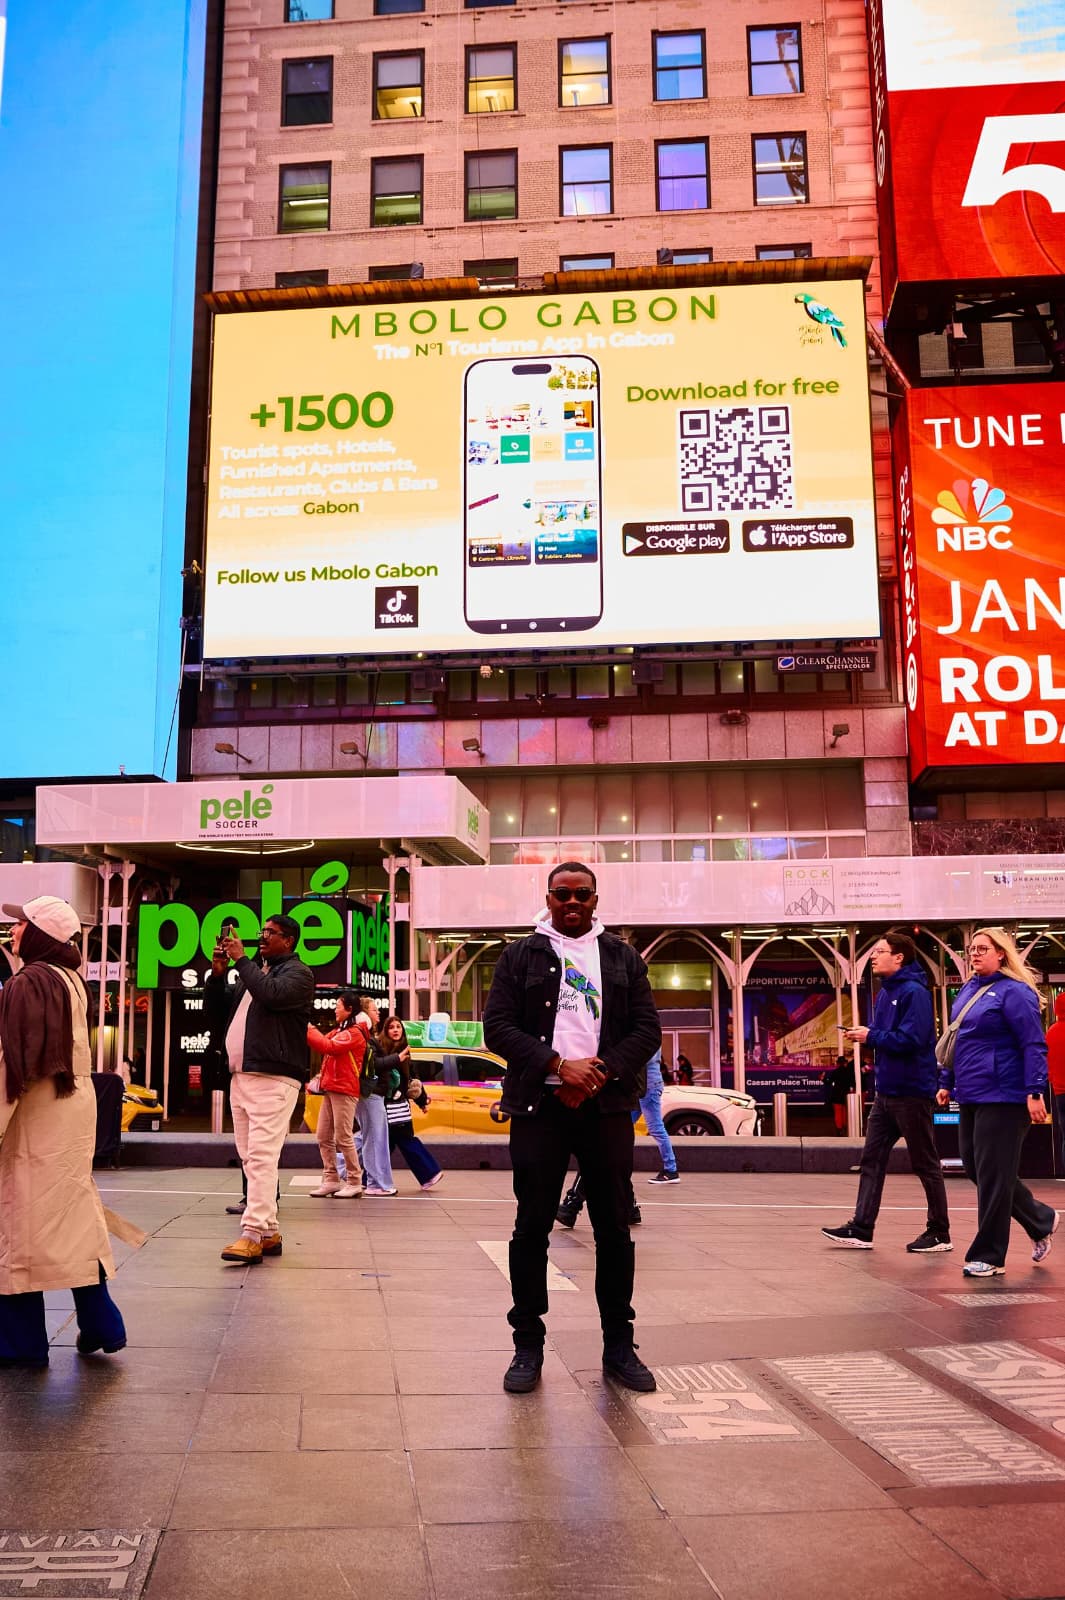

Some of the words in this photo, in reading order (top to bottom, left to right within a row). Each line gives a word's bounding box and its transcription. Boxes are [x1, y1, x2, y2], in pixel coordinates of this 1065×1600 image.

[331, 305, 507, 339] MBOLO
[537, 294, 716, 328] GABON
[373, 343, 411, 360] The
[446, 338, 538, 357] Tourisme
[542, 335, 583, 353] App
[586, 333, 607, 349] in
[609, 331, 675, 348] Gabon
[627, 380, 747, 402] Download
[754, 378, 786, 397] for
[792, 377, 839, 395] free
[250, 391, 394, 433] +1500
[923, 414, 1044, 449] TUNE
[221, 445, 279, 461] Tourist
[283, 442, 333, 460] spots,
[336, 438, 396, 455] Hotels,
[220, 461, 306, 480] Furnished
[309, 458, 417, 478] Apartments,
[219, 482, 326, 500] Restaurants,
[329, 478, 378, 495] Clubs
[382, 478, 394, 492] &
[398, 477, 438, 491] Bars
[218, 504, 240, 519] All
[244, 505, 299, 518] across
[645, 523, 695, 533] DISPONIBLE
[698, 522, 715, 531] SUR
[770, 523, 816, 533] Télécharger
[817, 522, 837, 531] dans
[809, 531, 847, 544] Store
[936, 525, 1014, 552] NBC
[646, 534, 697, 553] Google
[699, 533, 727, 549] play
[217, 569, 279, 585] Follow
[284, 569, 306, 583] us
[311, 565, 371, 581] Mbolo
[375, 562, 439, 579] Gabon
[936, 577, 1065, 635] JAN
[379, 613, 414, 624] TikTok
[944, 711, 1007, 747] AT
[1023, 709, 1065, 745] D
[200, 784, 274, 830] pelé
[215, 820, 258, 829] SOCCER
[785, 869, 830, 879] ROCK
[136, 860, 349, 989] pelé
[351, 892, 390, 985] pelé
[361, 971, 386, 991] SOCCER
[806, 977, 819, 985] OF
[180, 1030, 211, 1049] pelé
[655, 1364, 749, 1392] UDIO
[772, 1355, 984, 1425] BROADWAY
[635, 1392, 801, 1440] 54
[873, 1429, 1011, 1483] WILSON
